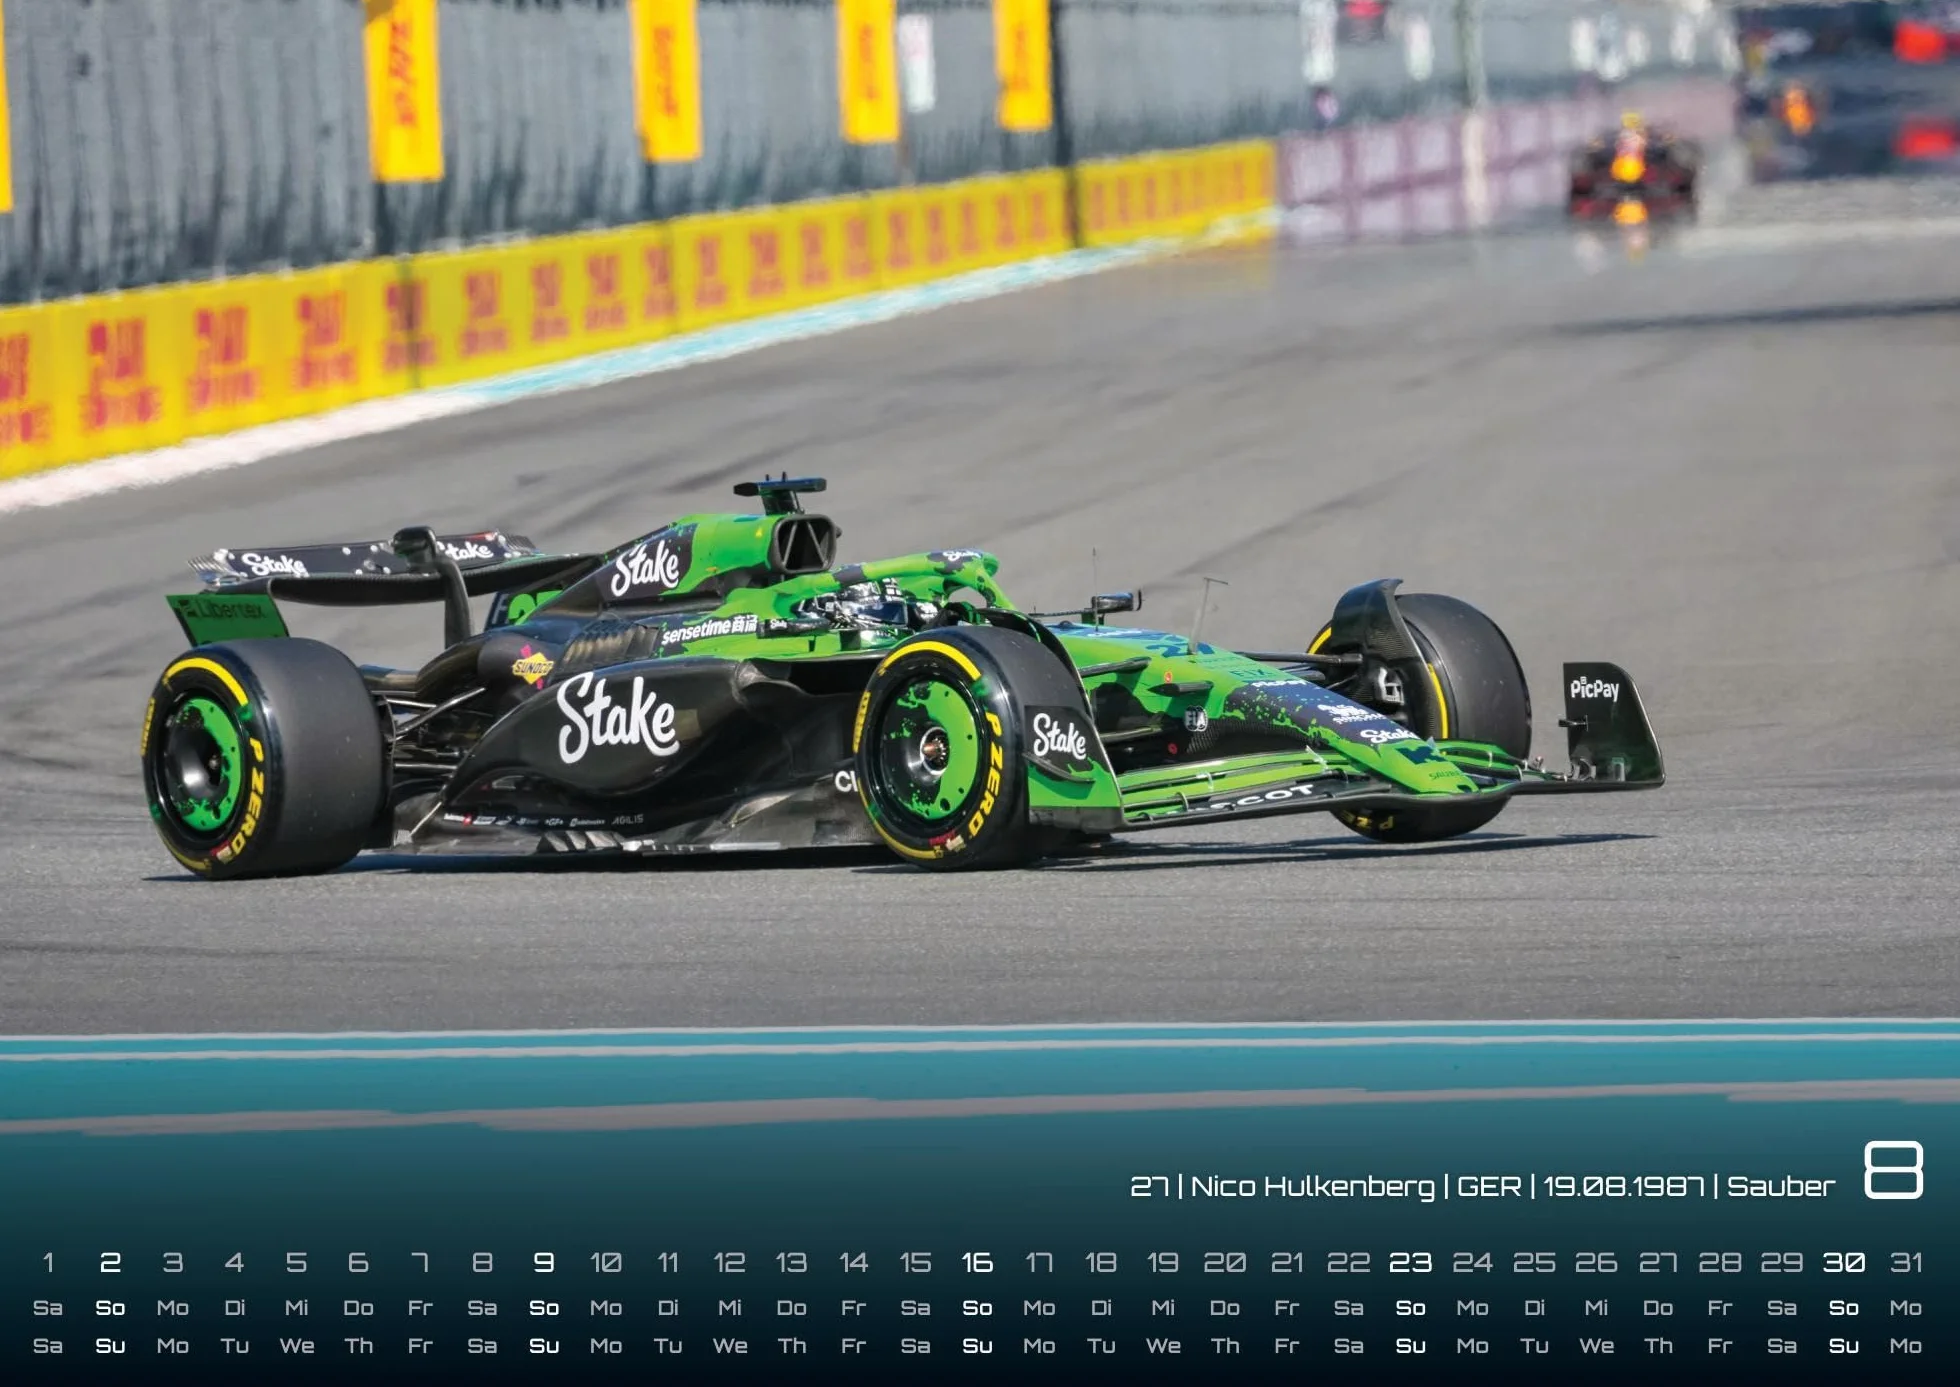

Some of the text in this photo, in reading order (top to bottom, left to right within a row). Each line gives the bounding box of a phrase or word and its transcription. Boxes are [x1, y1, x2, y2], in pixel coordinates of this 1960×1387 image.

[241, 553, 310, 578] Stake
[610, 540, 679, 597] Stake
[661, 619, 731, 646] sensetime
[514, 659, 554, 675] SUNOCO
[1570, 676, 1620, 703] PicPay
[556, 671, 681, 764] Stake
[1033, 713, 1086, 760] Stake
[230, 737, 265, 857] P ZERO
[967, 711, 1004, 839] P ZERO
